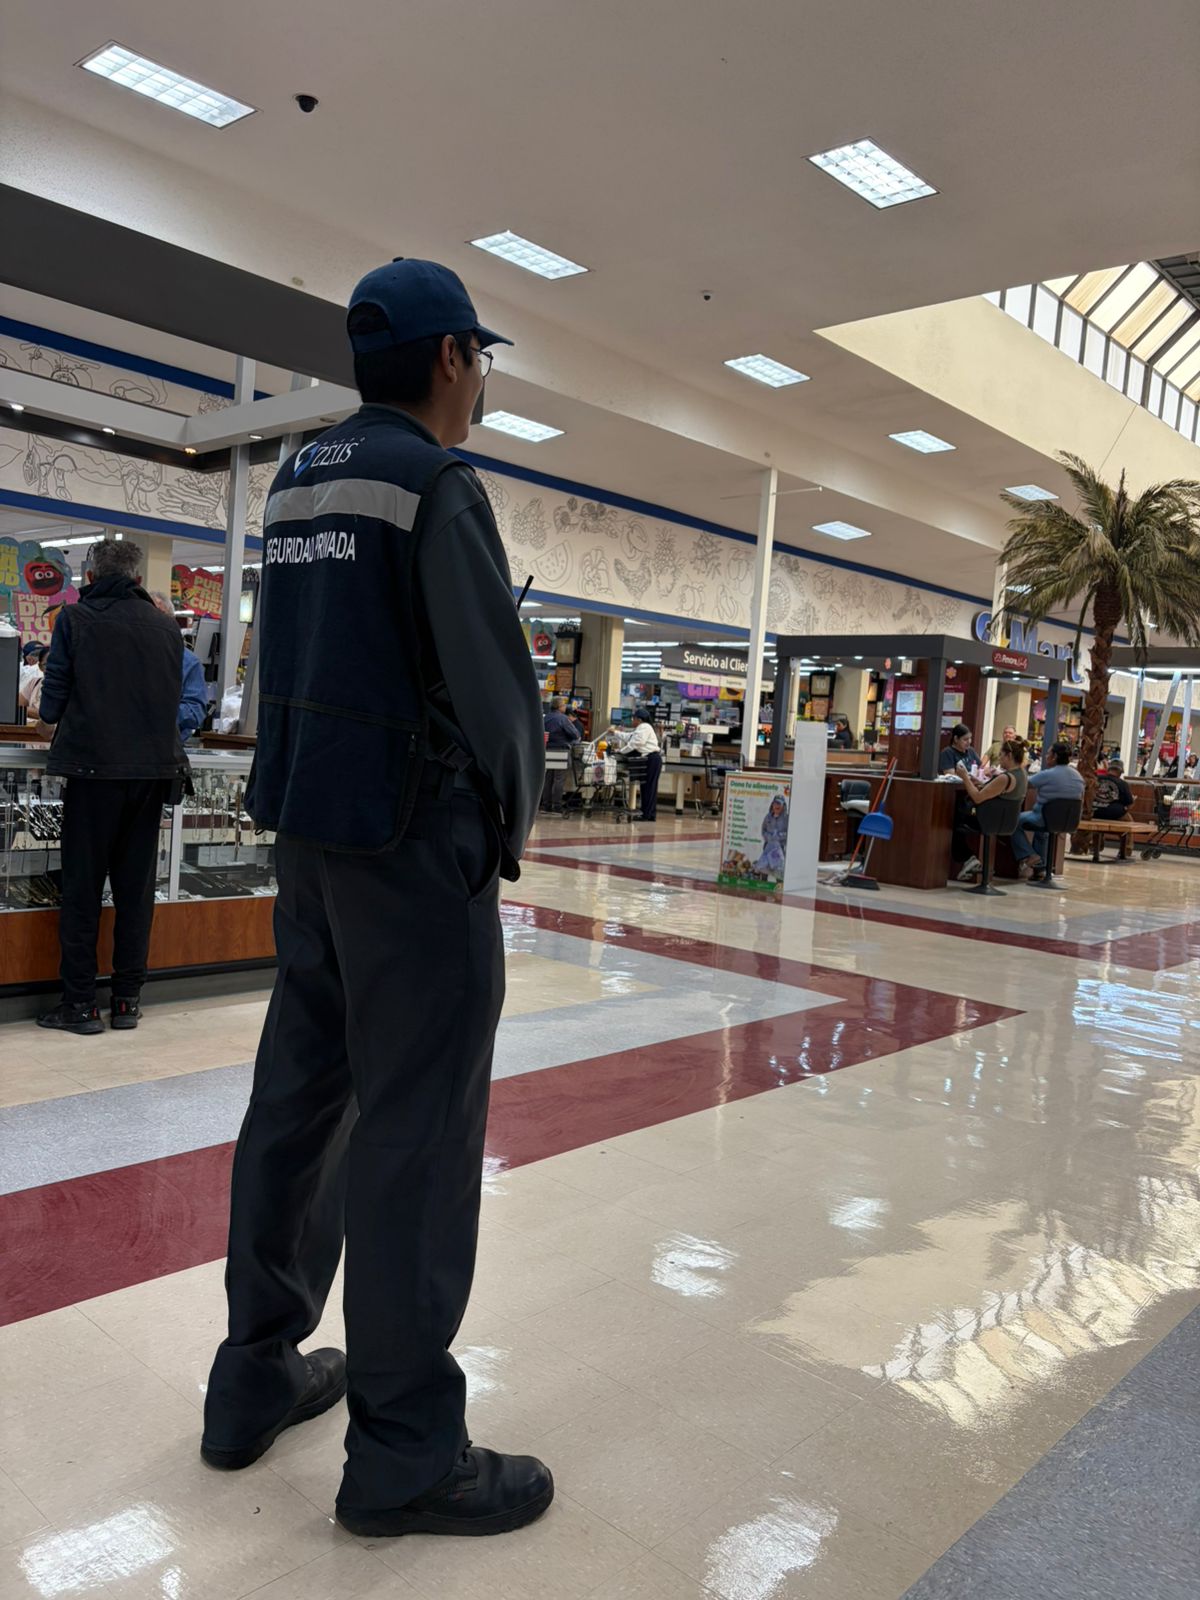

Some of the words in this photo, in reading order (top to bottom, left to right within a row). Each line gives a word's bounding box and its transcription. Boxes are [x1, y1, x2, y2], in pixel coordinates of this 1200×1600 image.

[311, 443, 359, 468] ZEUS
[194, 575, 222, 593] PUR
[190, 597, 222, 615] CUR
[683, 651, 719, 667] Servicio
[720, 657, 728, 670] al
